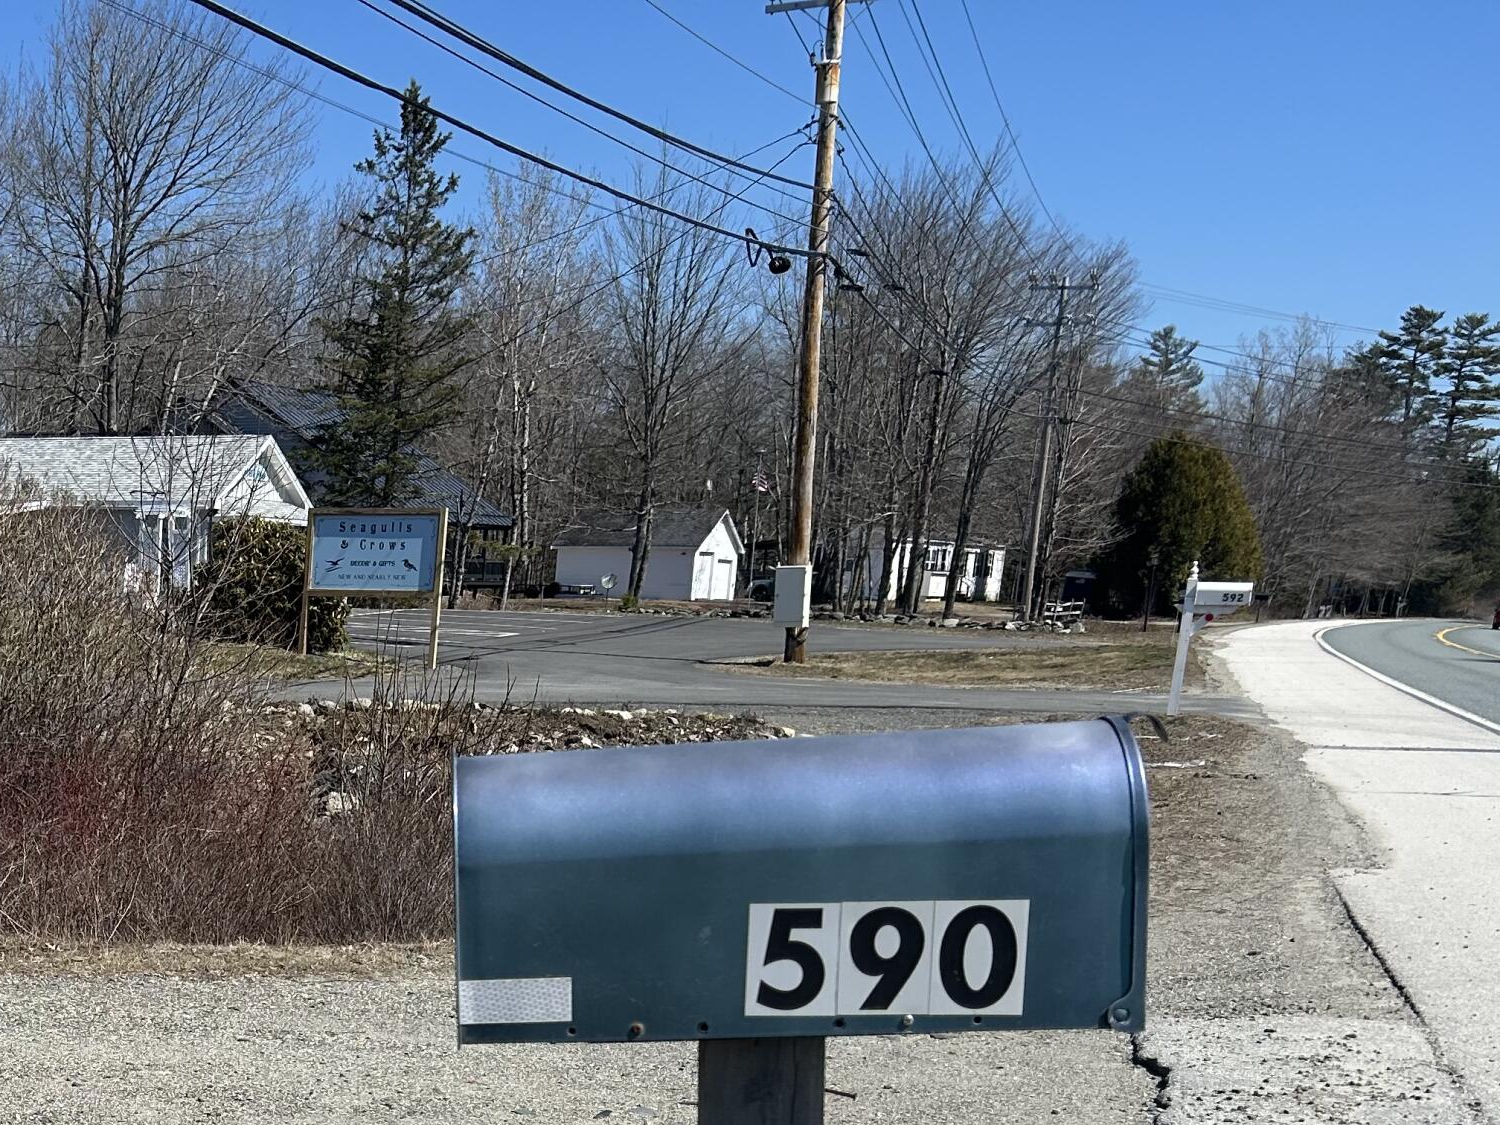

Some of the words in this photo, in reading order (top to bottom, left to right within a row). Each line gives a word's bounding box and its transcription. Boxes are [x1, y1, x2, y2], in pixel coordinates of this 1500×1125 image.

[339, 521, 413, 535] Seagulls
[340, 539, 349, 549] &
[360, 539, 406, 550] Crows
[1222, 593, 1244, 602] 592
[755, 904, 1018, 1011] 590
